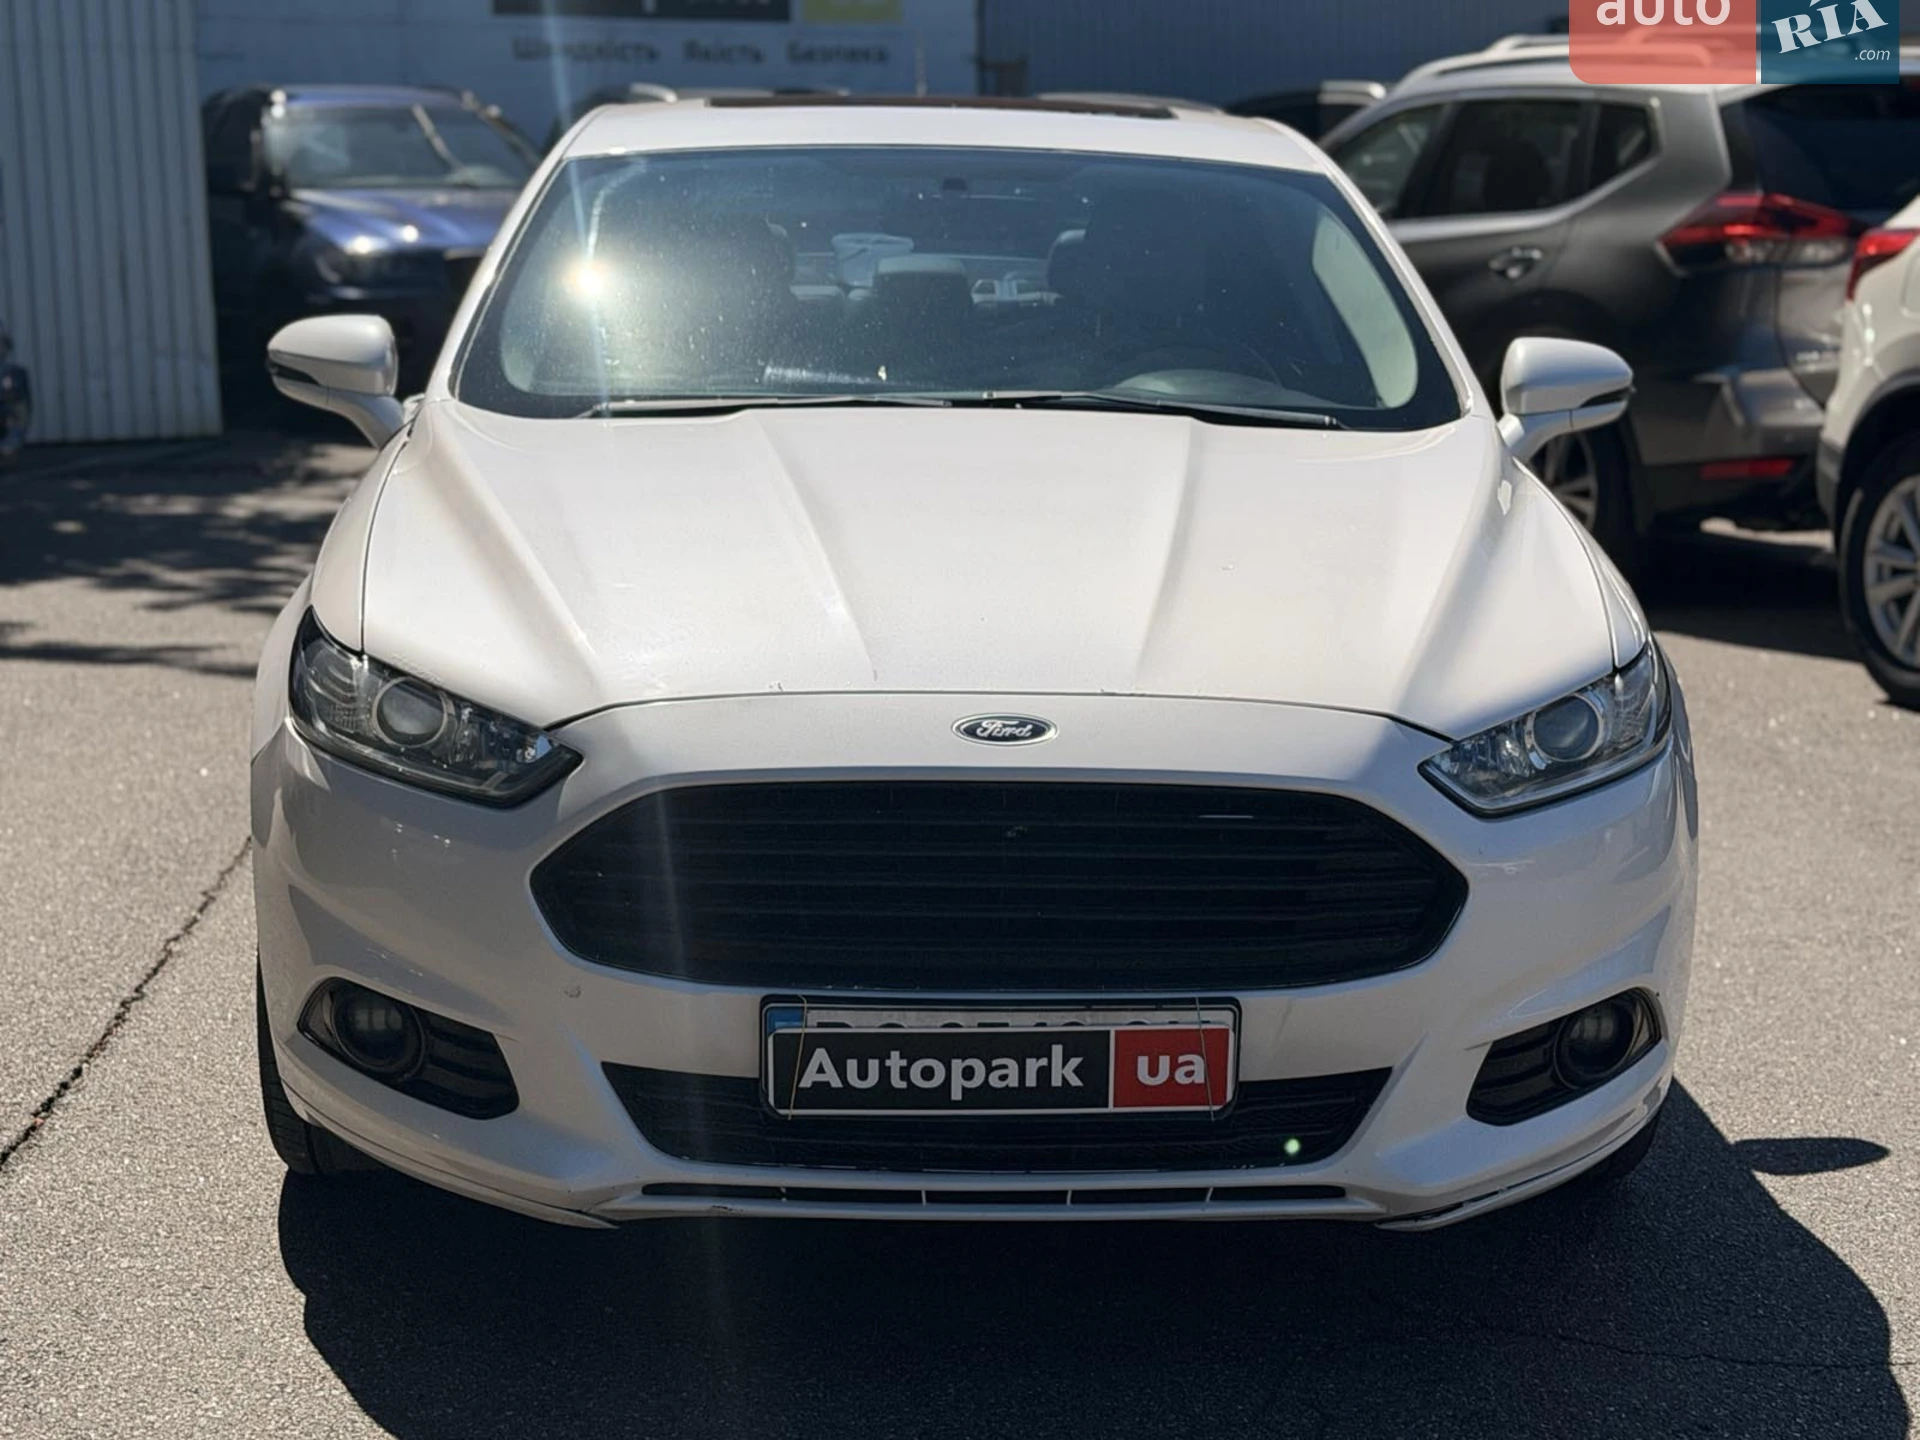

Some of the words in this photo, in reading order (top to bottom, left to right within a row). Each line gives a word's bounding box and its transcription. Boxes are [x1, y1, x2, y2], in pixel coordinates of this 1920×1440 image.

[976, 719, 1032, 737] Ford
[799, 1044, 1084, 1101] Autopark
[1136, 1054, 1206, 1085] ua
